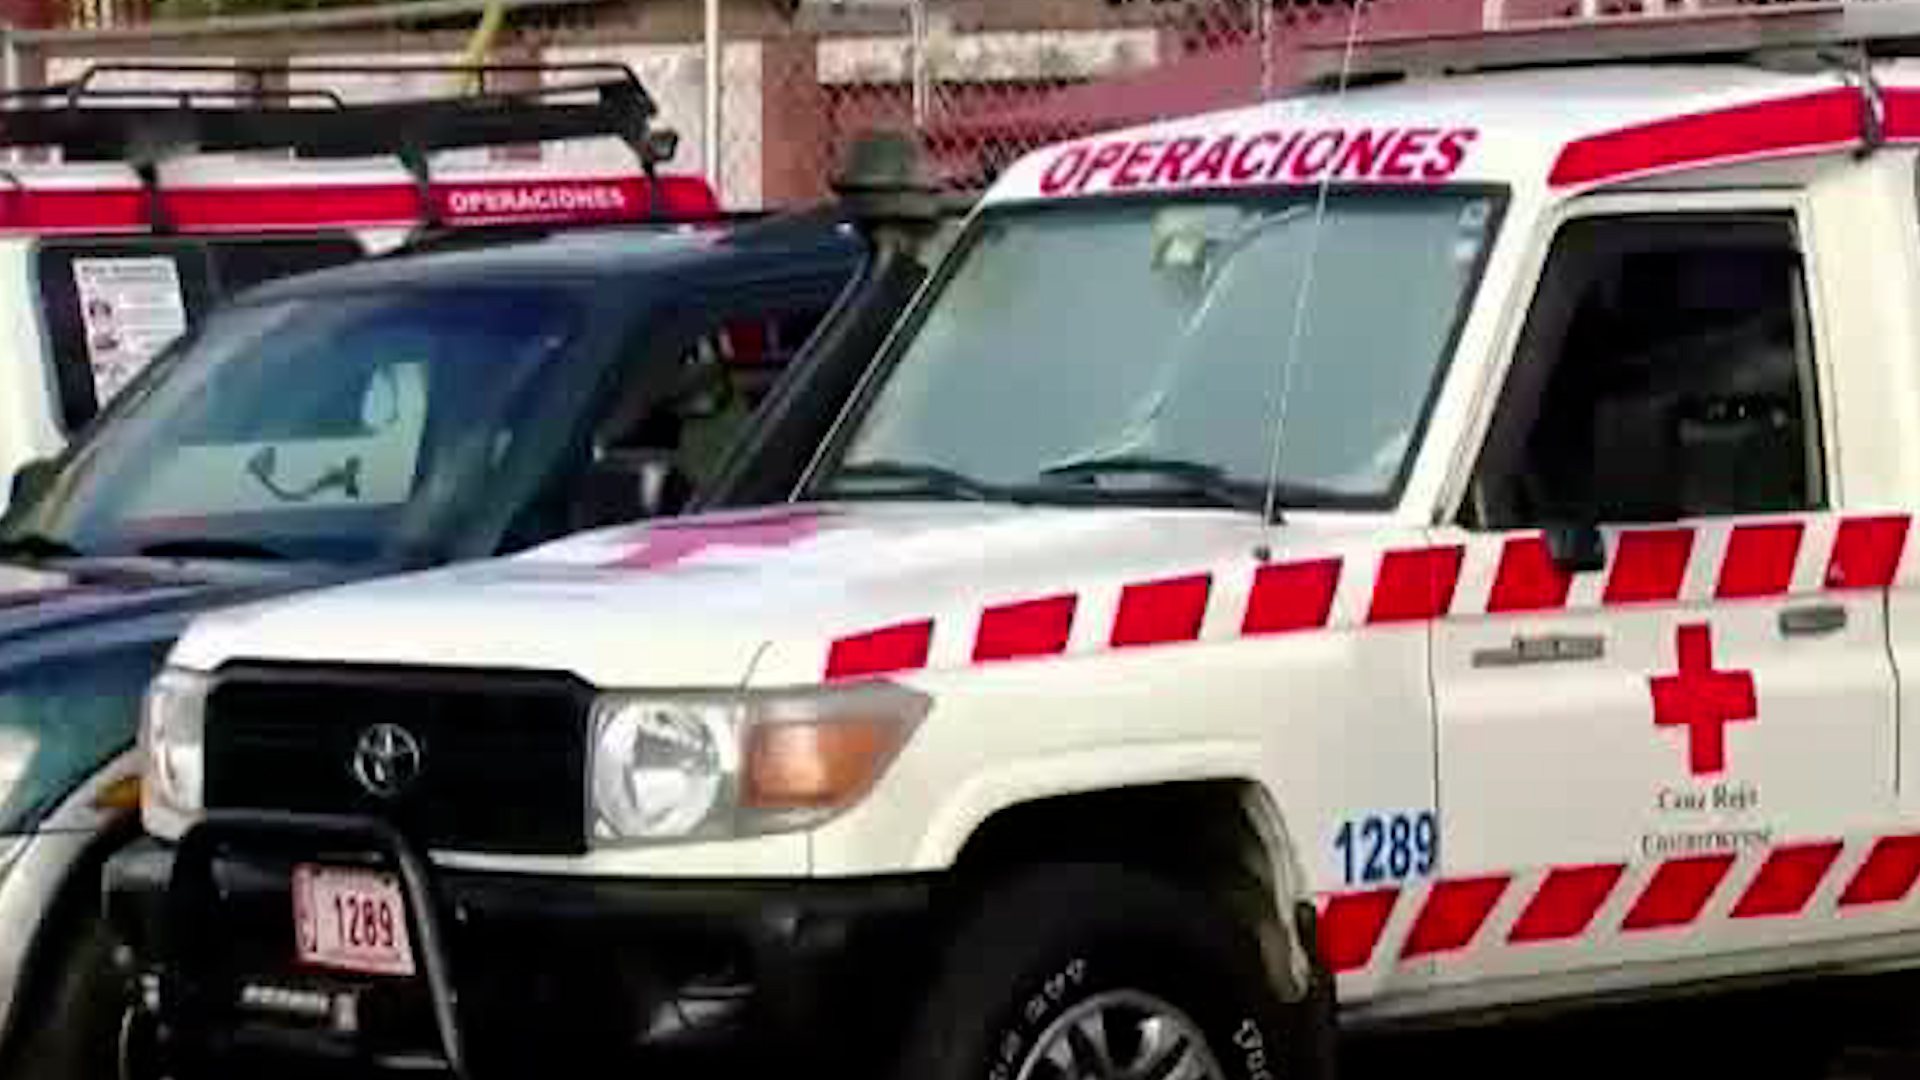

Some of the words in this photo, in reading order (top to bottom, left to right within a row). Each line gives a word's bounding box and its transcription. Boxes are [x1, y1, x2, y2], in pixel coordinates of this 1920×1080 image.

[1039, 128, 1478, 196] OPERACIONES
[448, 186, 626, 213] OPERACIONES
[1334, 812, 1438, 884] 1289
[334, 895, 394, 946] 1289
